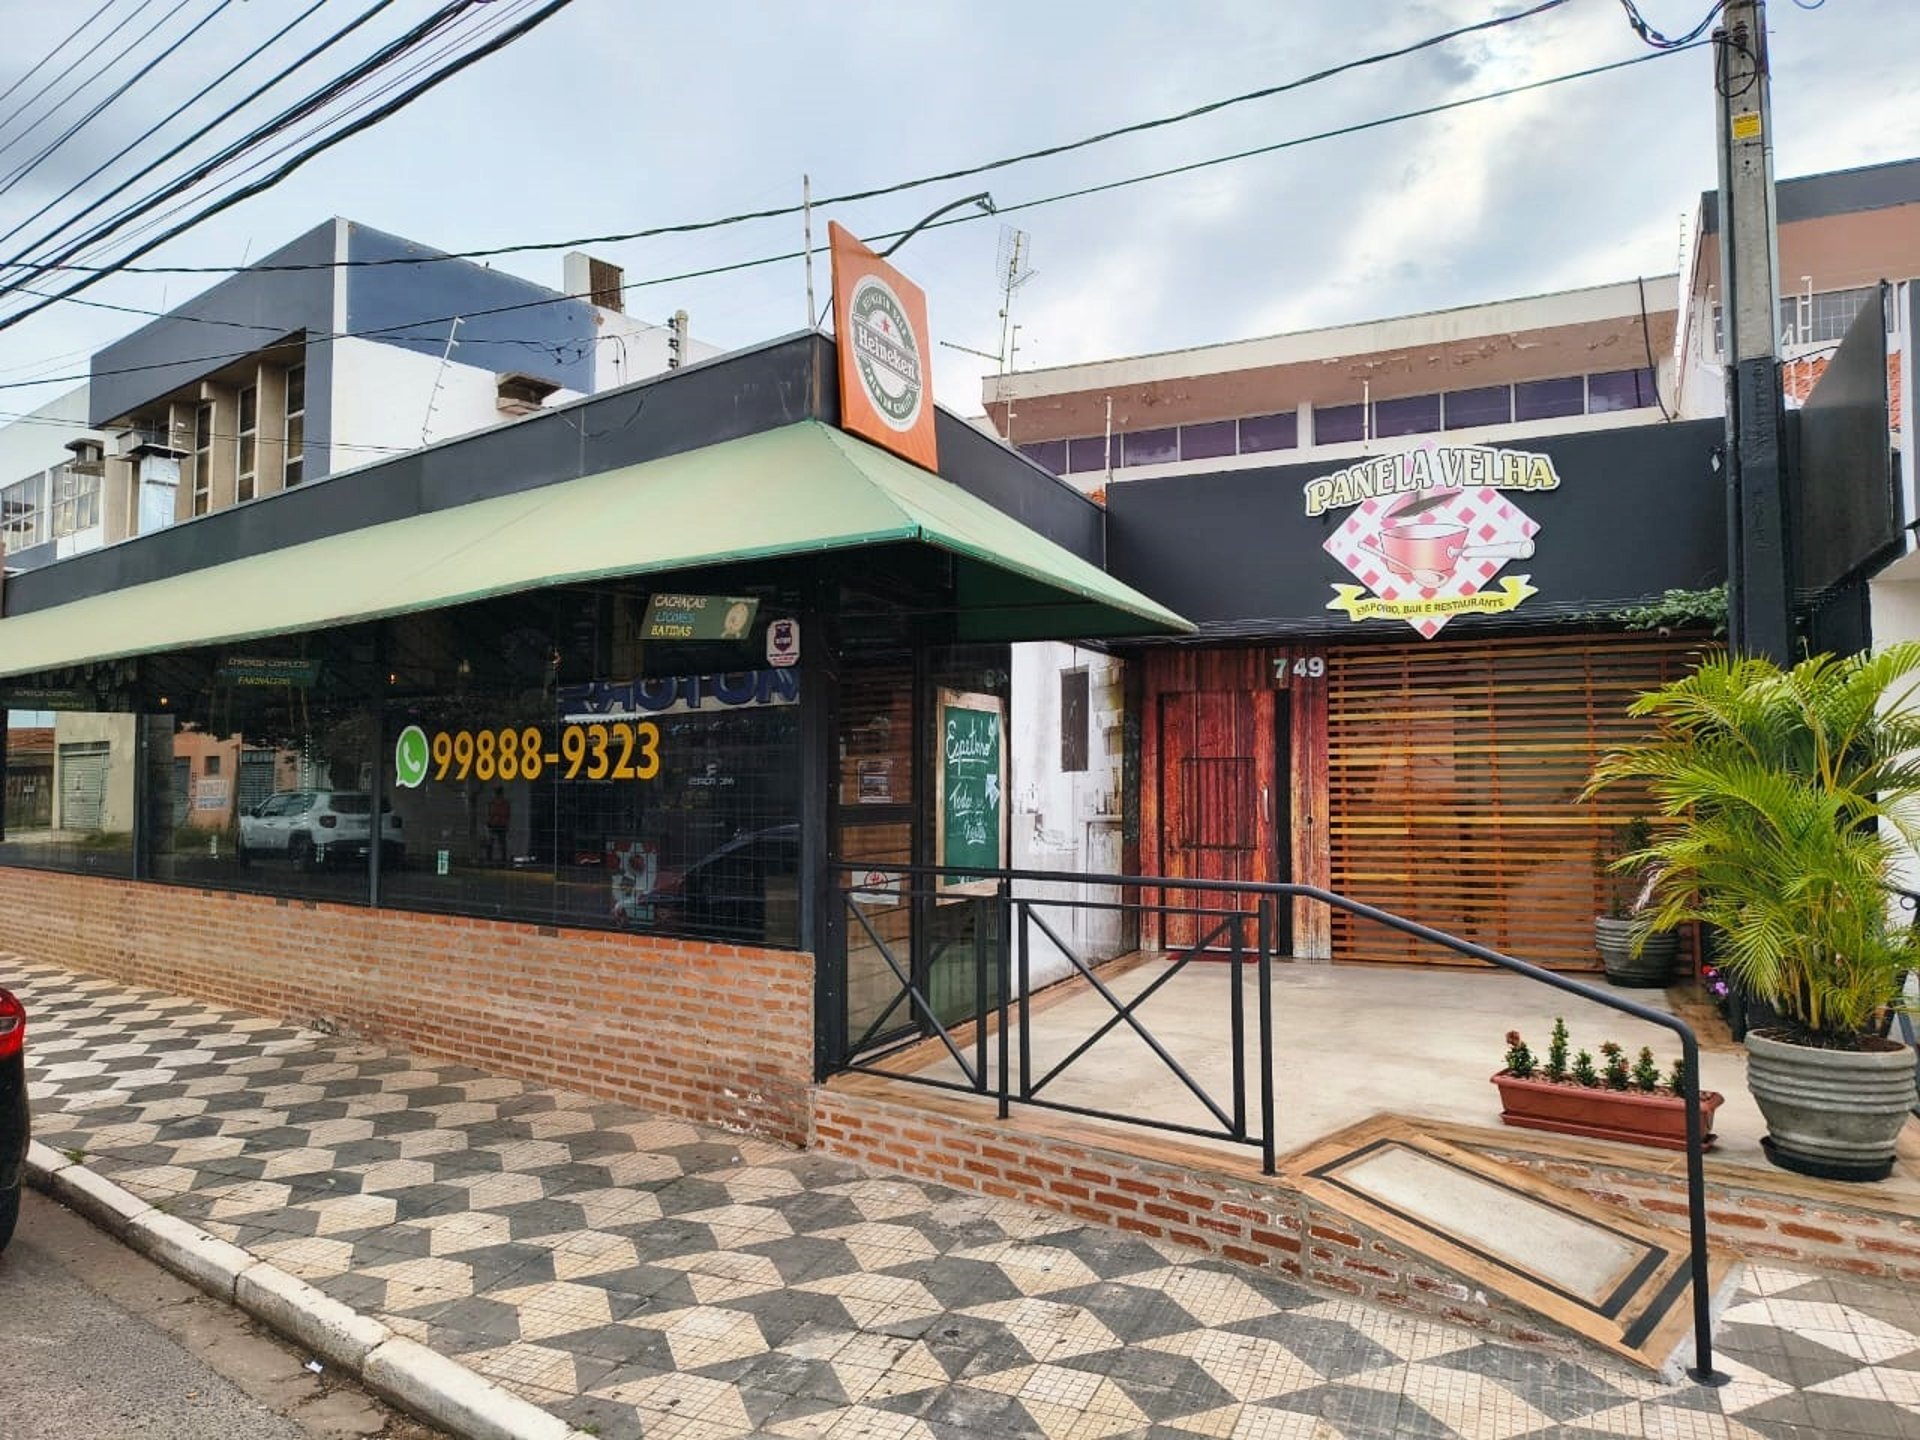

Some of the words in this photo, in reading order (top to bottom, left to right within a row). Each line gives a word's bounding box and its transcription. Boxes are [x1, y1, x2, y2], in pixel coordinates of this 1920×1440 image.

[858, 325, 915, 379] Heineken
[1307, 449, 1434, 514] PANELA
[1437, 448, 1557, 488] VELHA
[1403, 604, 1423, 614] BAR
[1425, 604, 1432, 613] E
[1434, 598, 1505, 613] RESTAURANTE
[1273, 656, 1324, 679] 749
[433, 721, 660, 781] 99888-9323
